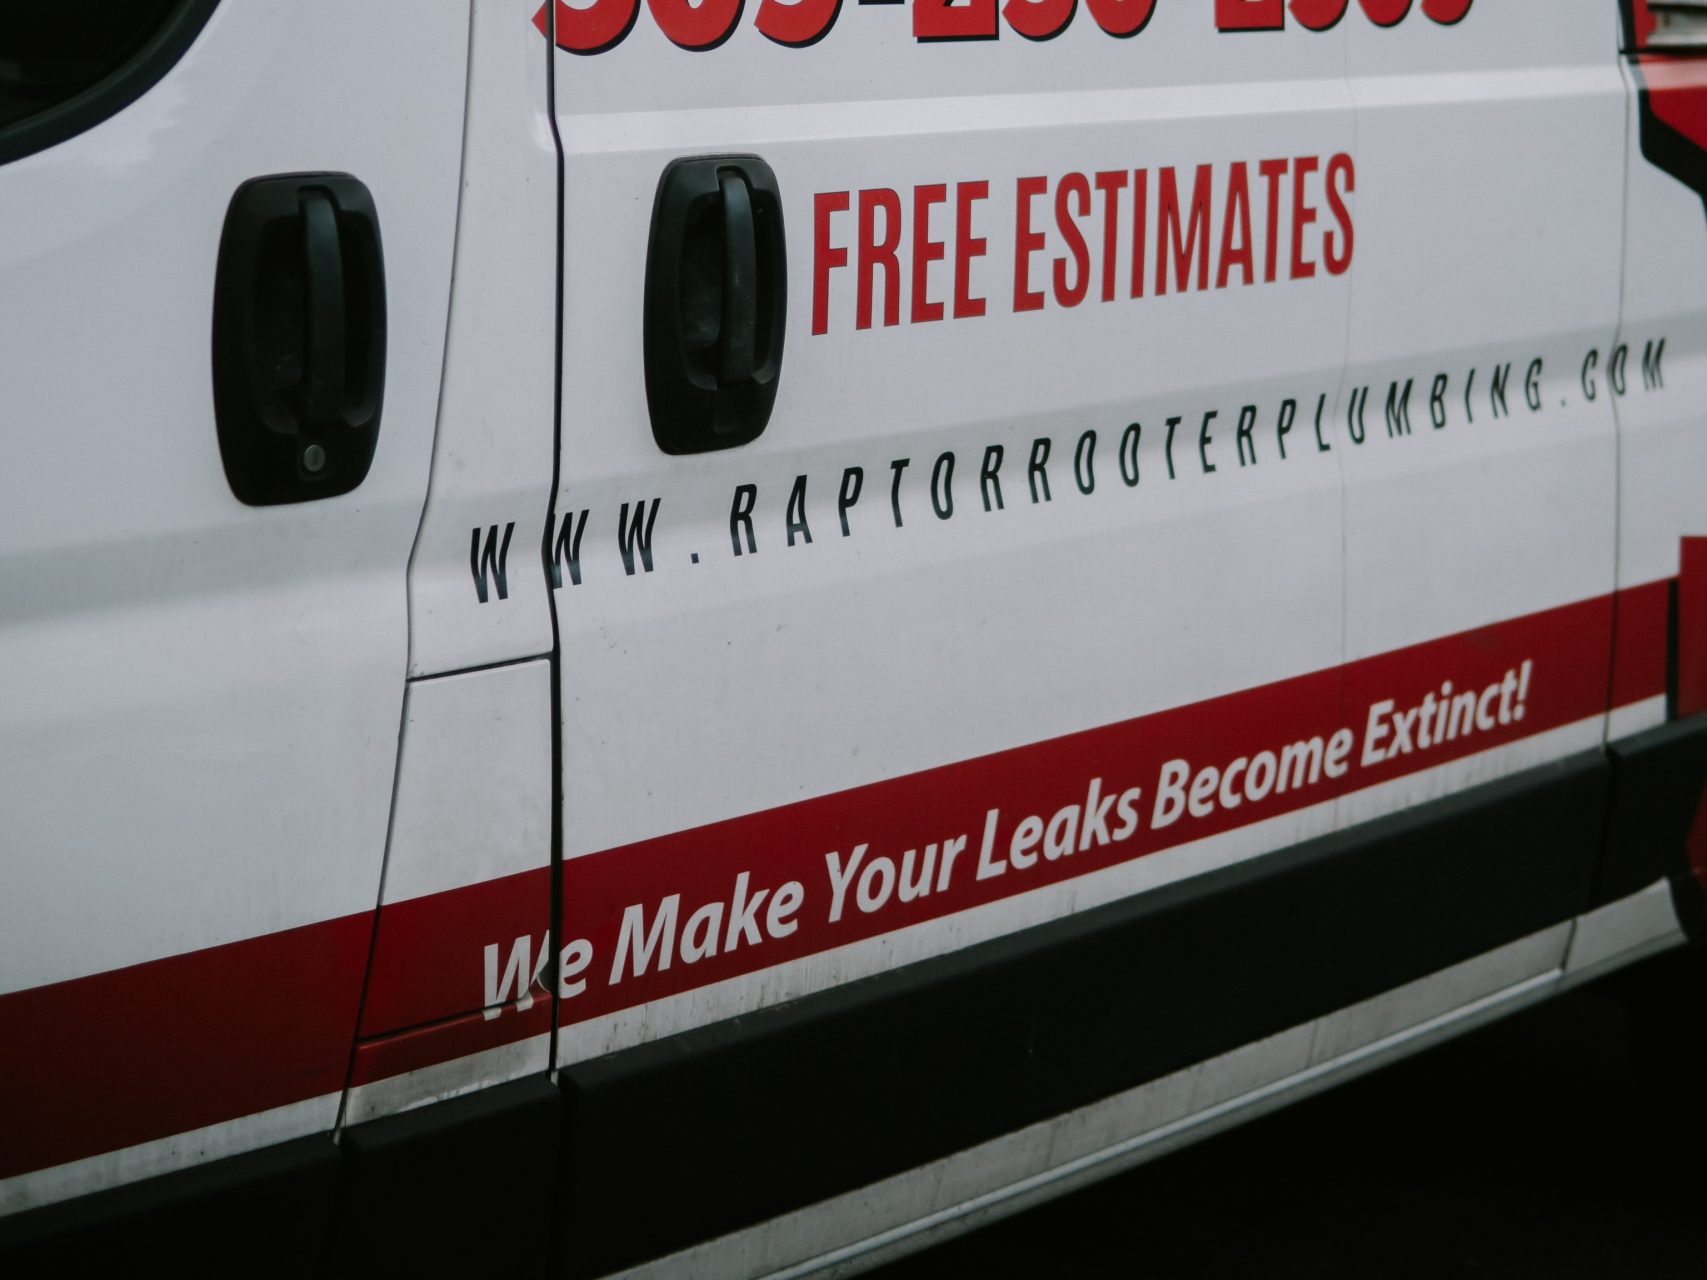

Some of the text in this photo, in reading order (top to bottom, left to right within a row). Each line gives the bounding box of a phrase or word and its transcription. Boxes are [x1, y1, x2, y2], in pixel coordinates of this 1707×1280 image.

[811, 152, 1355, 336] FREE ESTIMATES
[470, 338, 1667, 604] WWW.RAPTORROOTERPLUMBING.COM
[483, 660, 1533, 1021] We Make Your Leaks Become Extinct!
